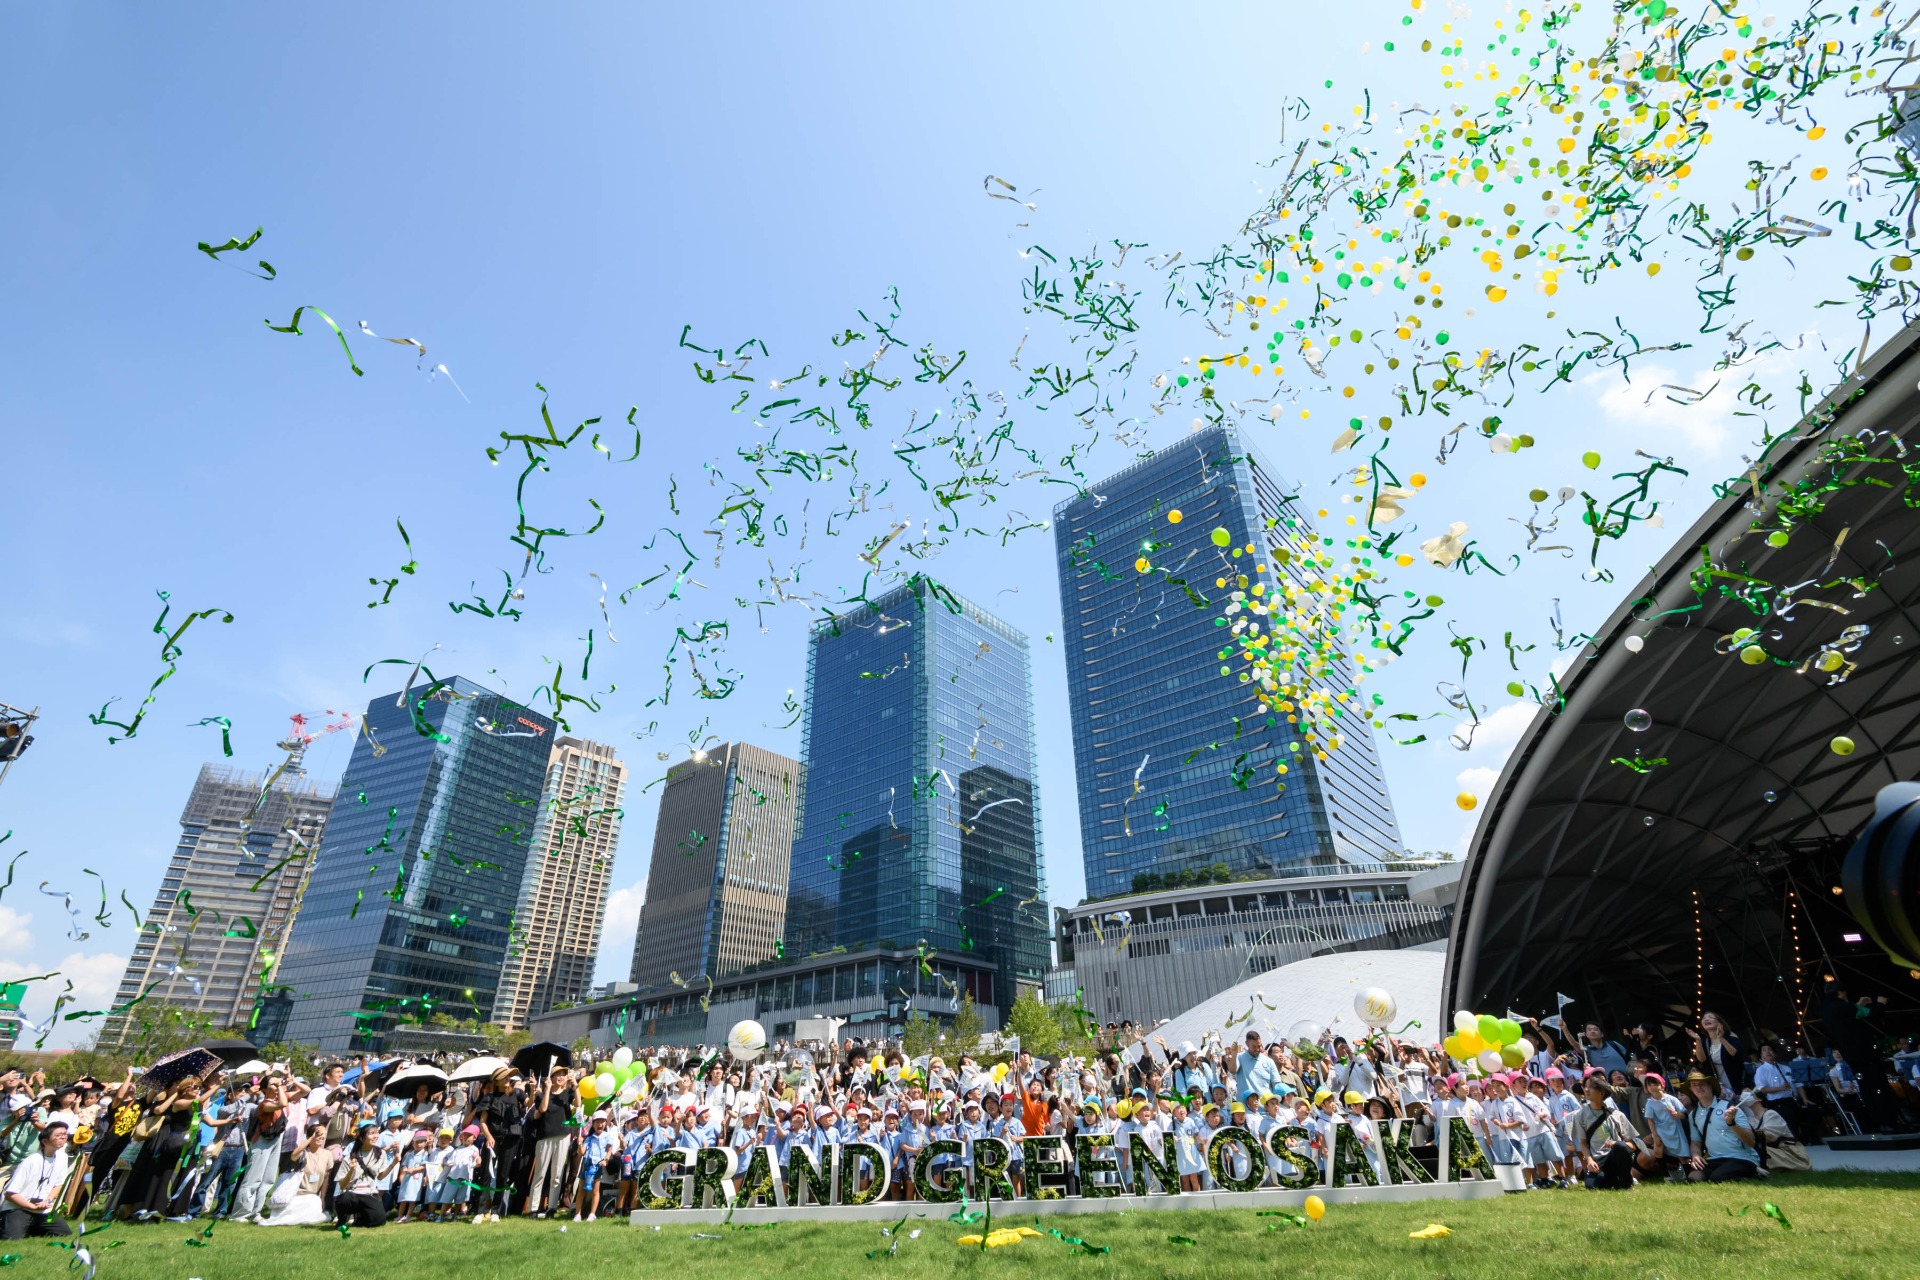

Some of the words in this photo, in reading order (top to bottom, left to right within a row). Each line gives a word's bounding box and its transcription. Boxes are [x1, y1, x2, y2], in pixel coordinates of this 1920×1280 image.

[518, 717, 548, 736] canopy
[638, 1142, 892, 1209] GRAND
[914, 1131, 1181, 1202] GREEN
[1205, 1116, 1496, 1192] OSAKA
